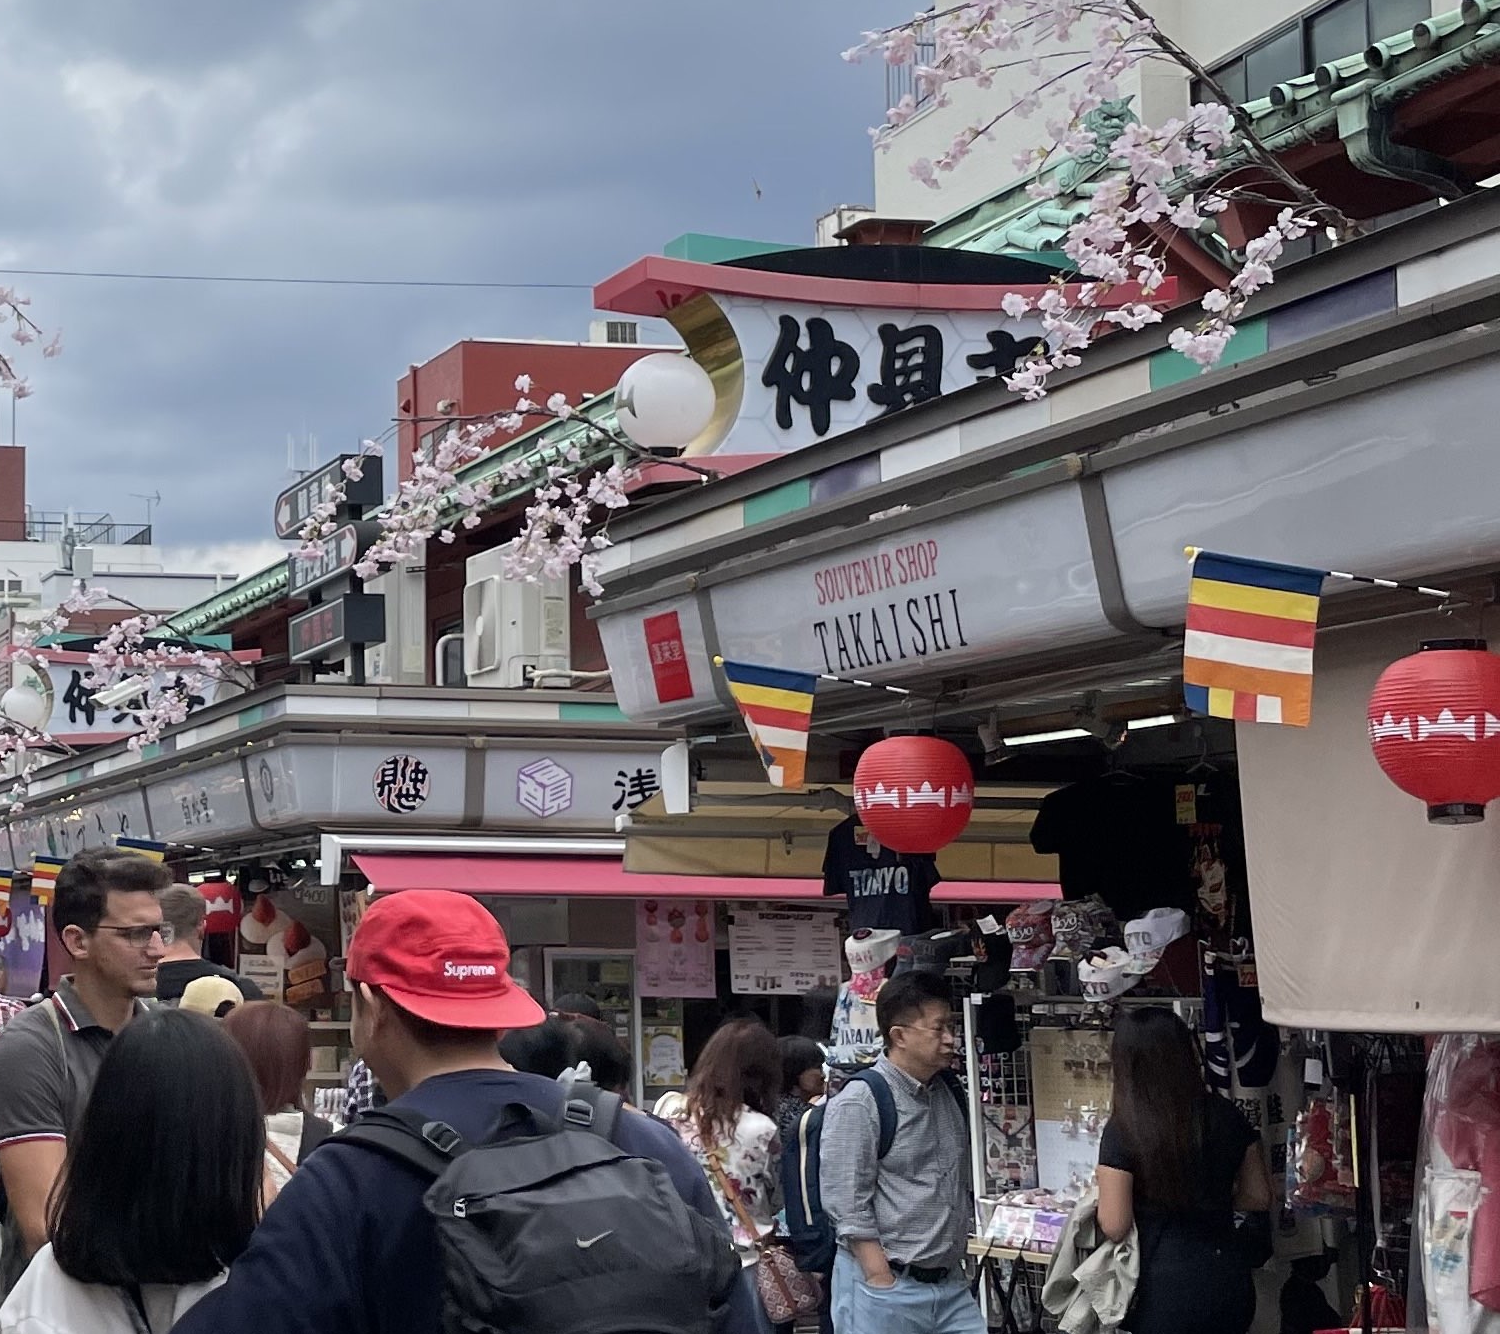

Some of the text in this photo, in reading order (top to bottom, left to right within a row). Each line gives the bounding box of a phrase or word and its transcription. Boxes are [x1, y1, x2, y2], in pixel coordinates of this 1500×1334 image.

[814, 539, 940, 606] SOUVENIR SHOP
[813, 588, 968, 675] TAKAISHI
[848, 866, 910, 898] TOKYO
[443, 961, 496, 980] Supreme
[840, 1028, 874, 1046] JAPAN
